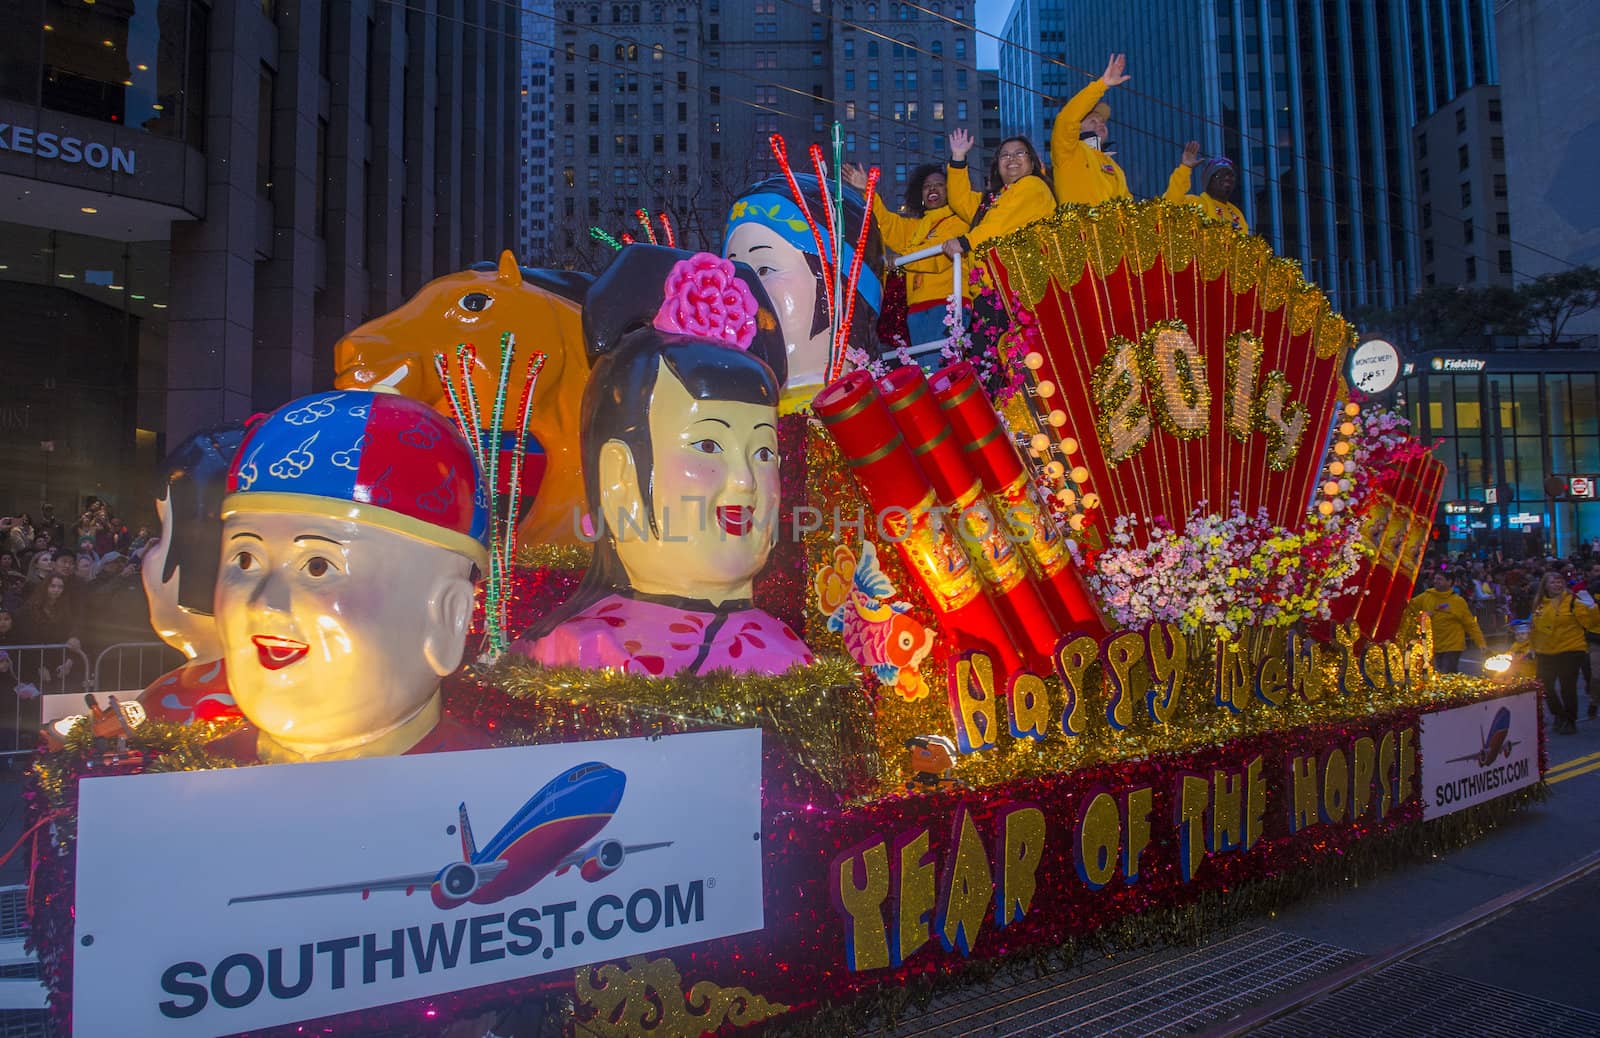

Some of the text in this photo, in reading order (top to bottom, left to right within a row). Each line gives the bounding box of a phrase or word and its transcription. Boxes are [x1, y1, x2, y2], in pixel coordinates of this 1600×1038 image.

[1090, 319, 1311, 472] 2014
[1444, 358, 1485, 371] Fidelity
[836, 727, 1416, 971] YEAR OF THE HORSE
[1436, 758, 1529, 807] SOUTHWEST.COM
[159, 879, 704, 1018] SOUTHWEST.COM
